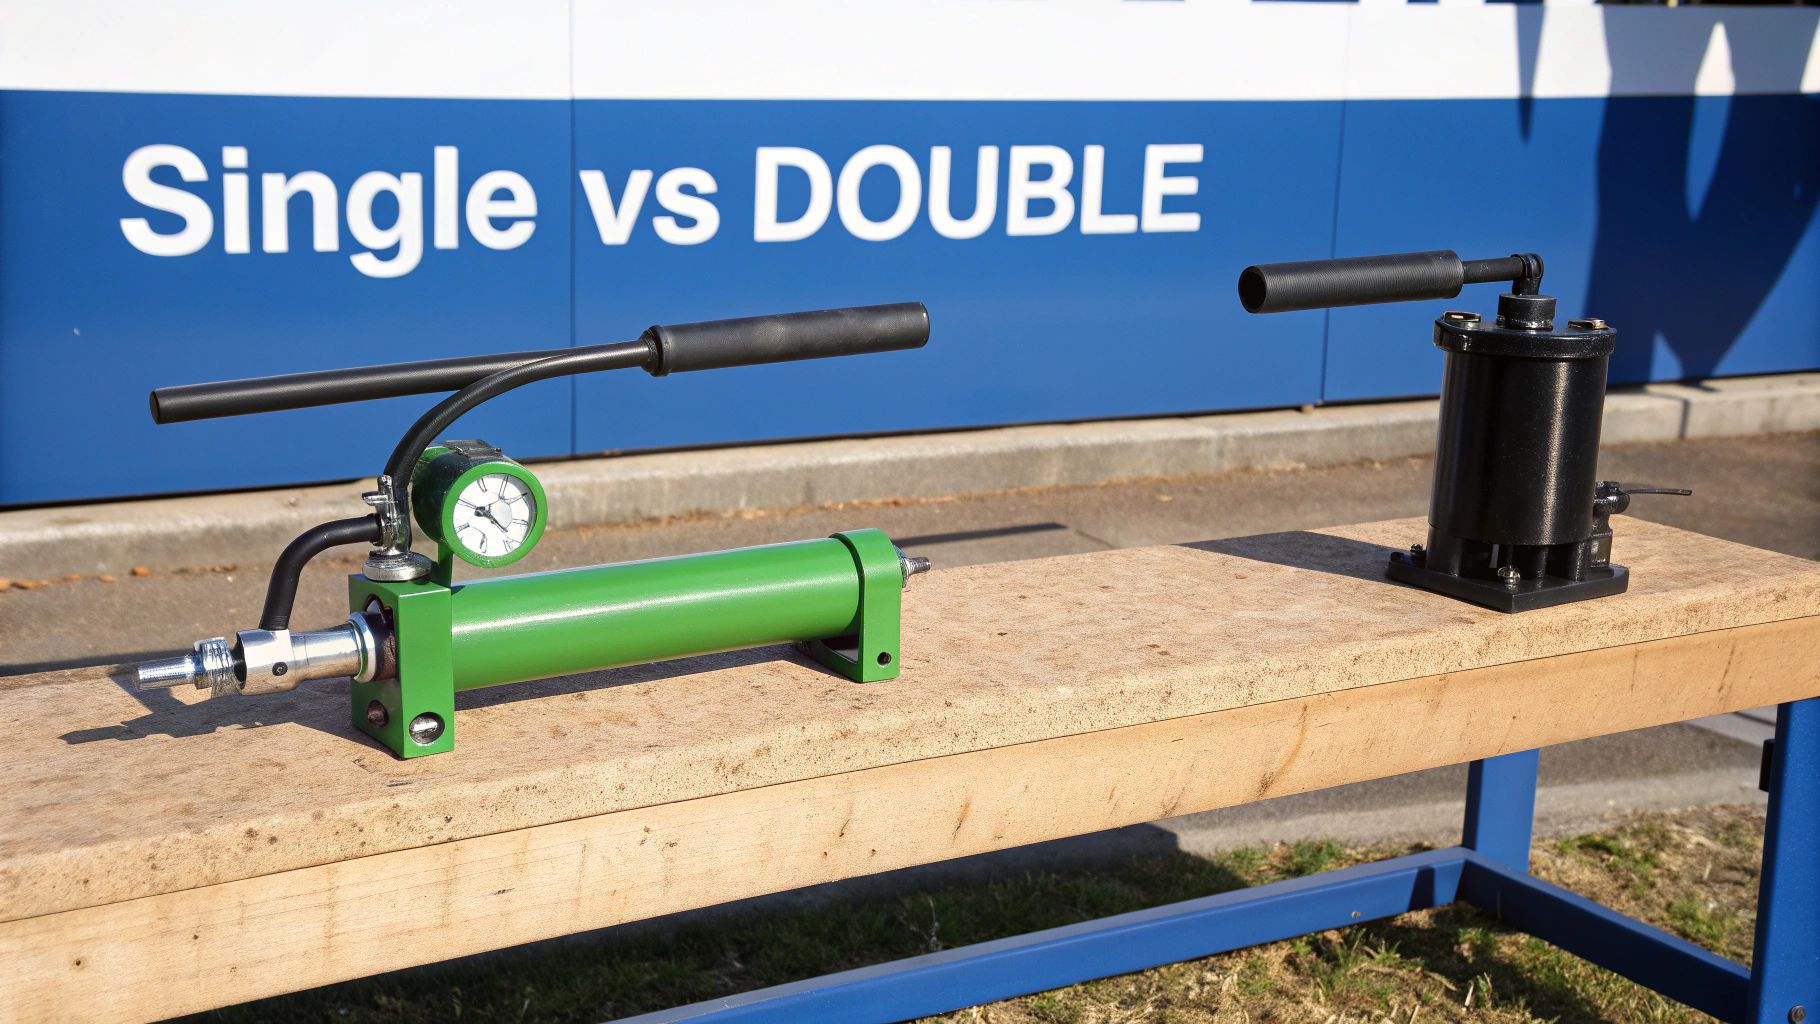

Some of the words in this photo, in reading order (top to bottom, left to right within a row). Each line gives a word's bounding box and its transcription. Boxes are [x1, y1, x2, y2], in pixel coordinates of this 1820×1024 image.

[120, 143, 538, 279] Single
[579, 166, 721, 246] vs
[753, 144, 1204, 243] DOUBLE
